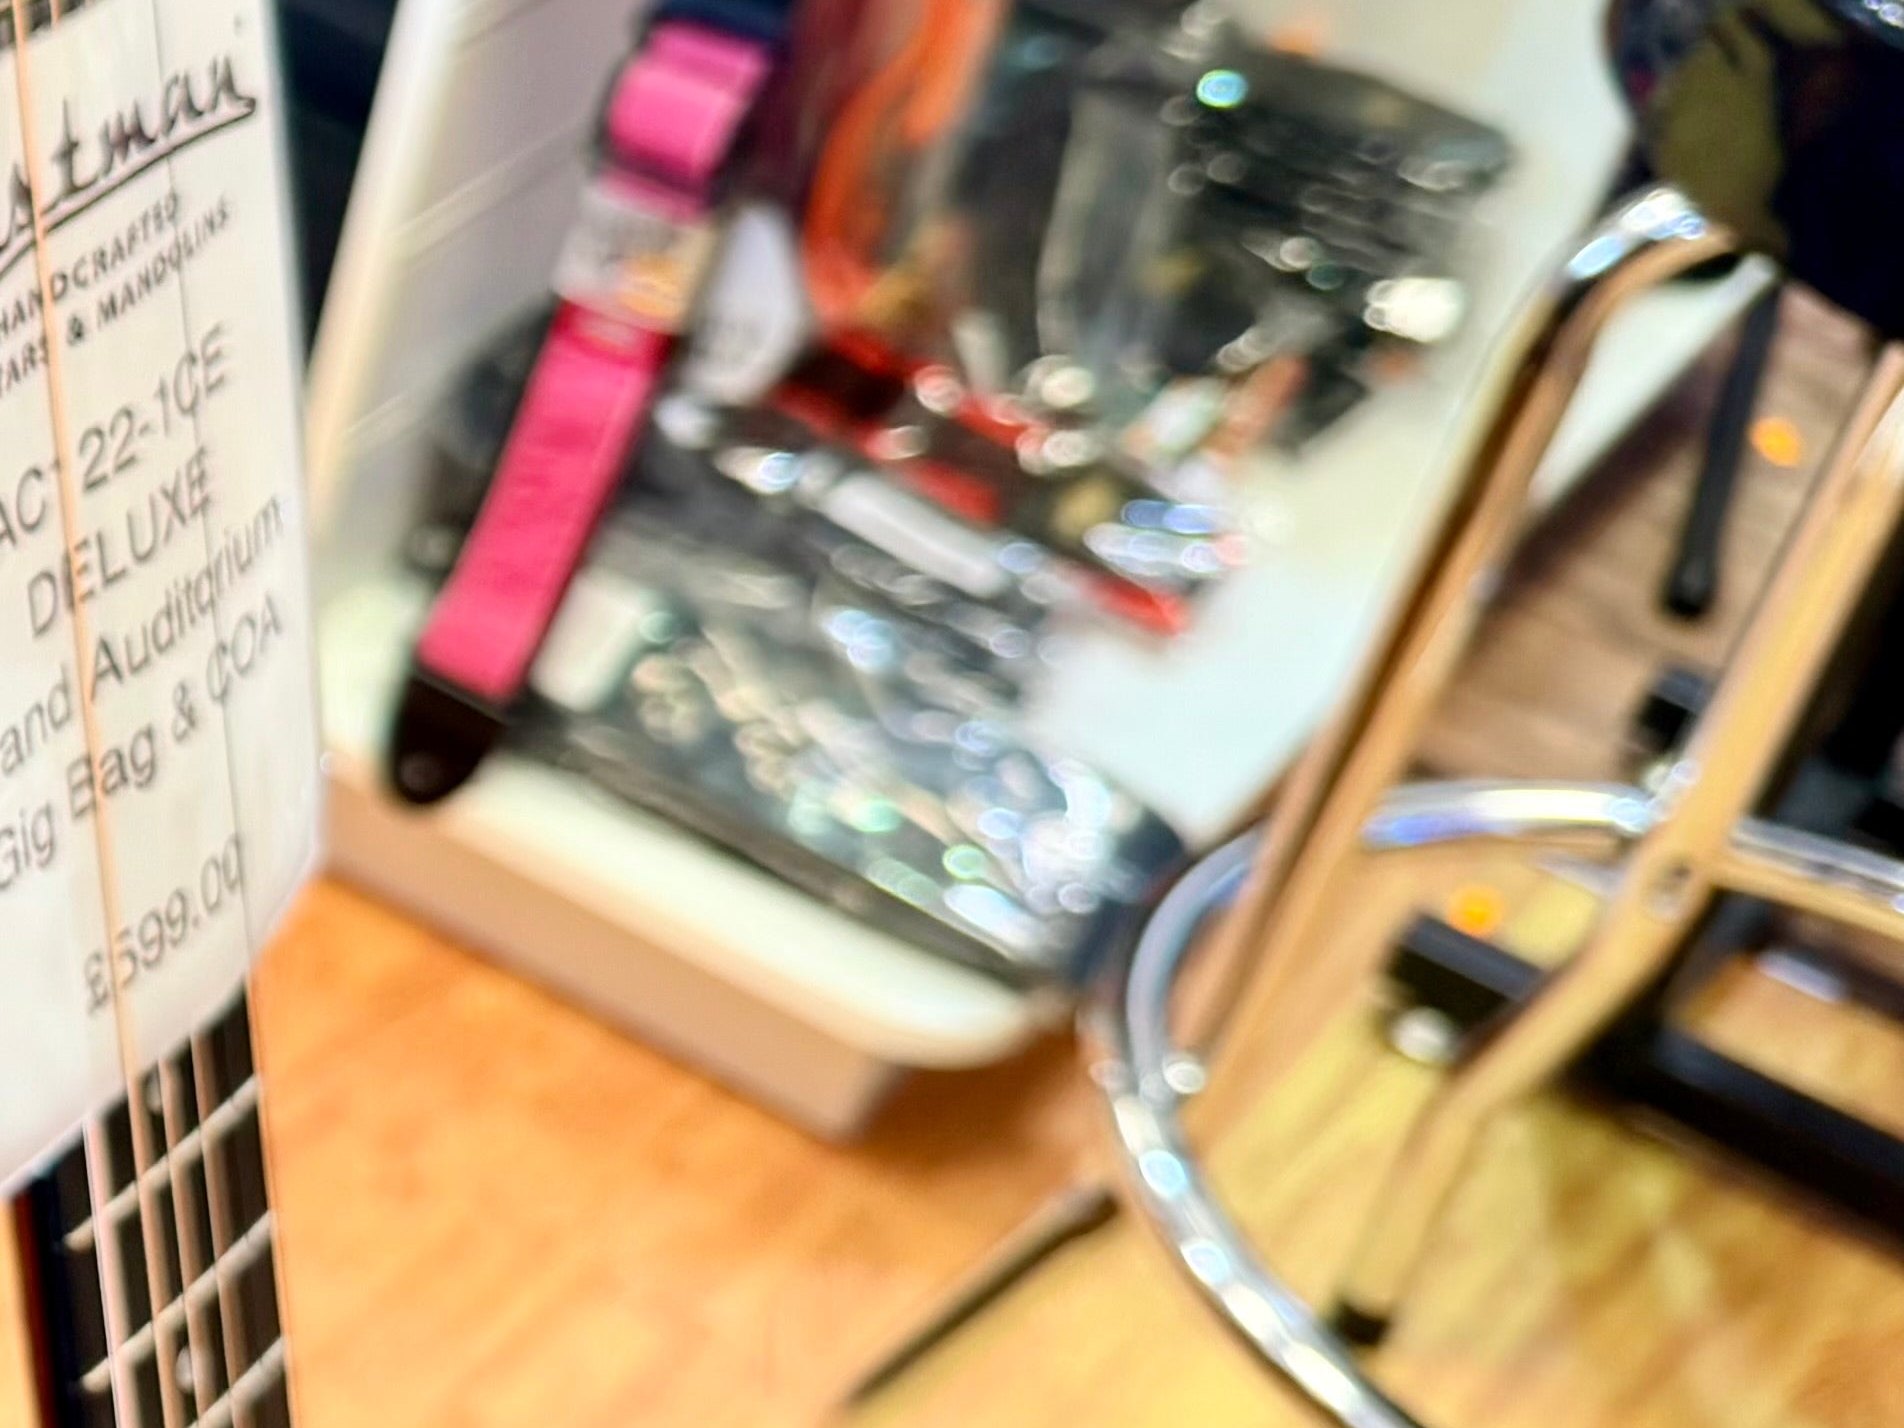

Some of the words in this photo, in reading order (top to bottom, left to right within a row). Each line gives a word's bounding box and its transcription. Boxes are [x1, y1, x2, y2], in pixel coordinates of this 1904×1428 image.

[66, 314, 89, 347] &
[96, 192, 231, 332] MANDOLINS
[27, 446, 210, 638] DELUXE
[91, 494, 284, 703] Auditorium
[68, 725, 156, 821] Bag
[172, 680, 198, 744] &
[207, 588, 283, 704] COA
[83, 833, 244, 1017] £599.00
